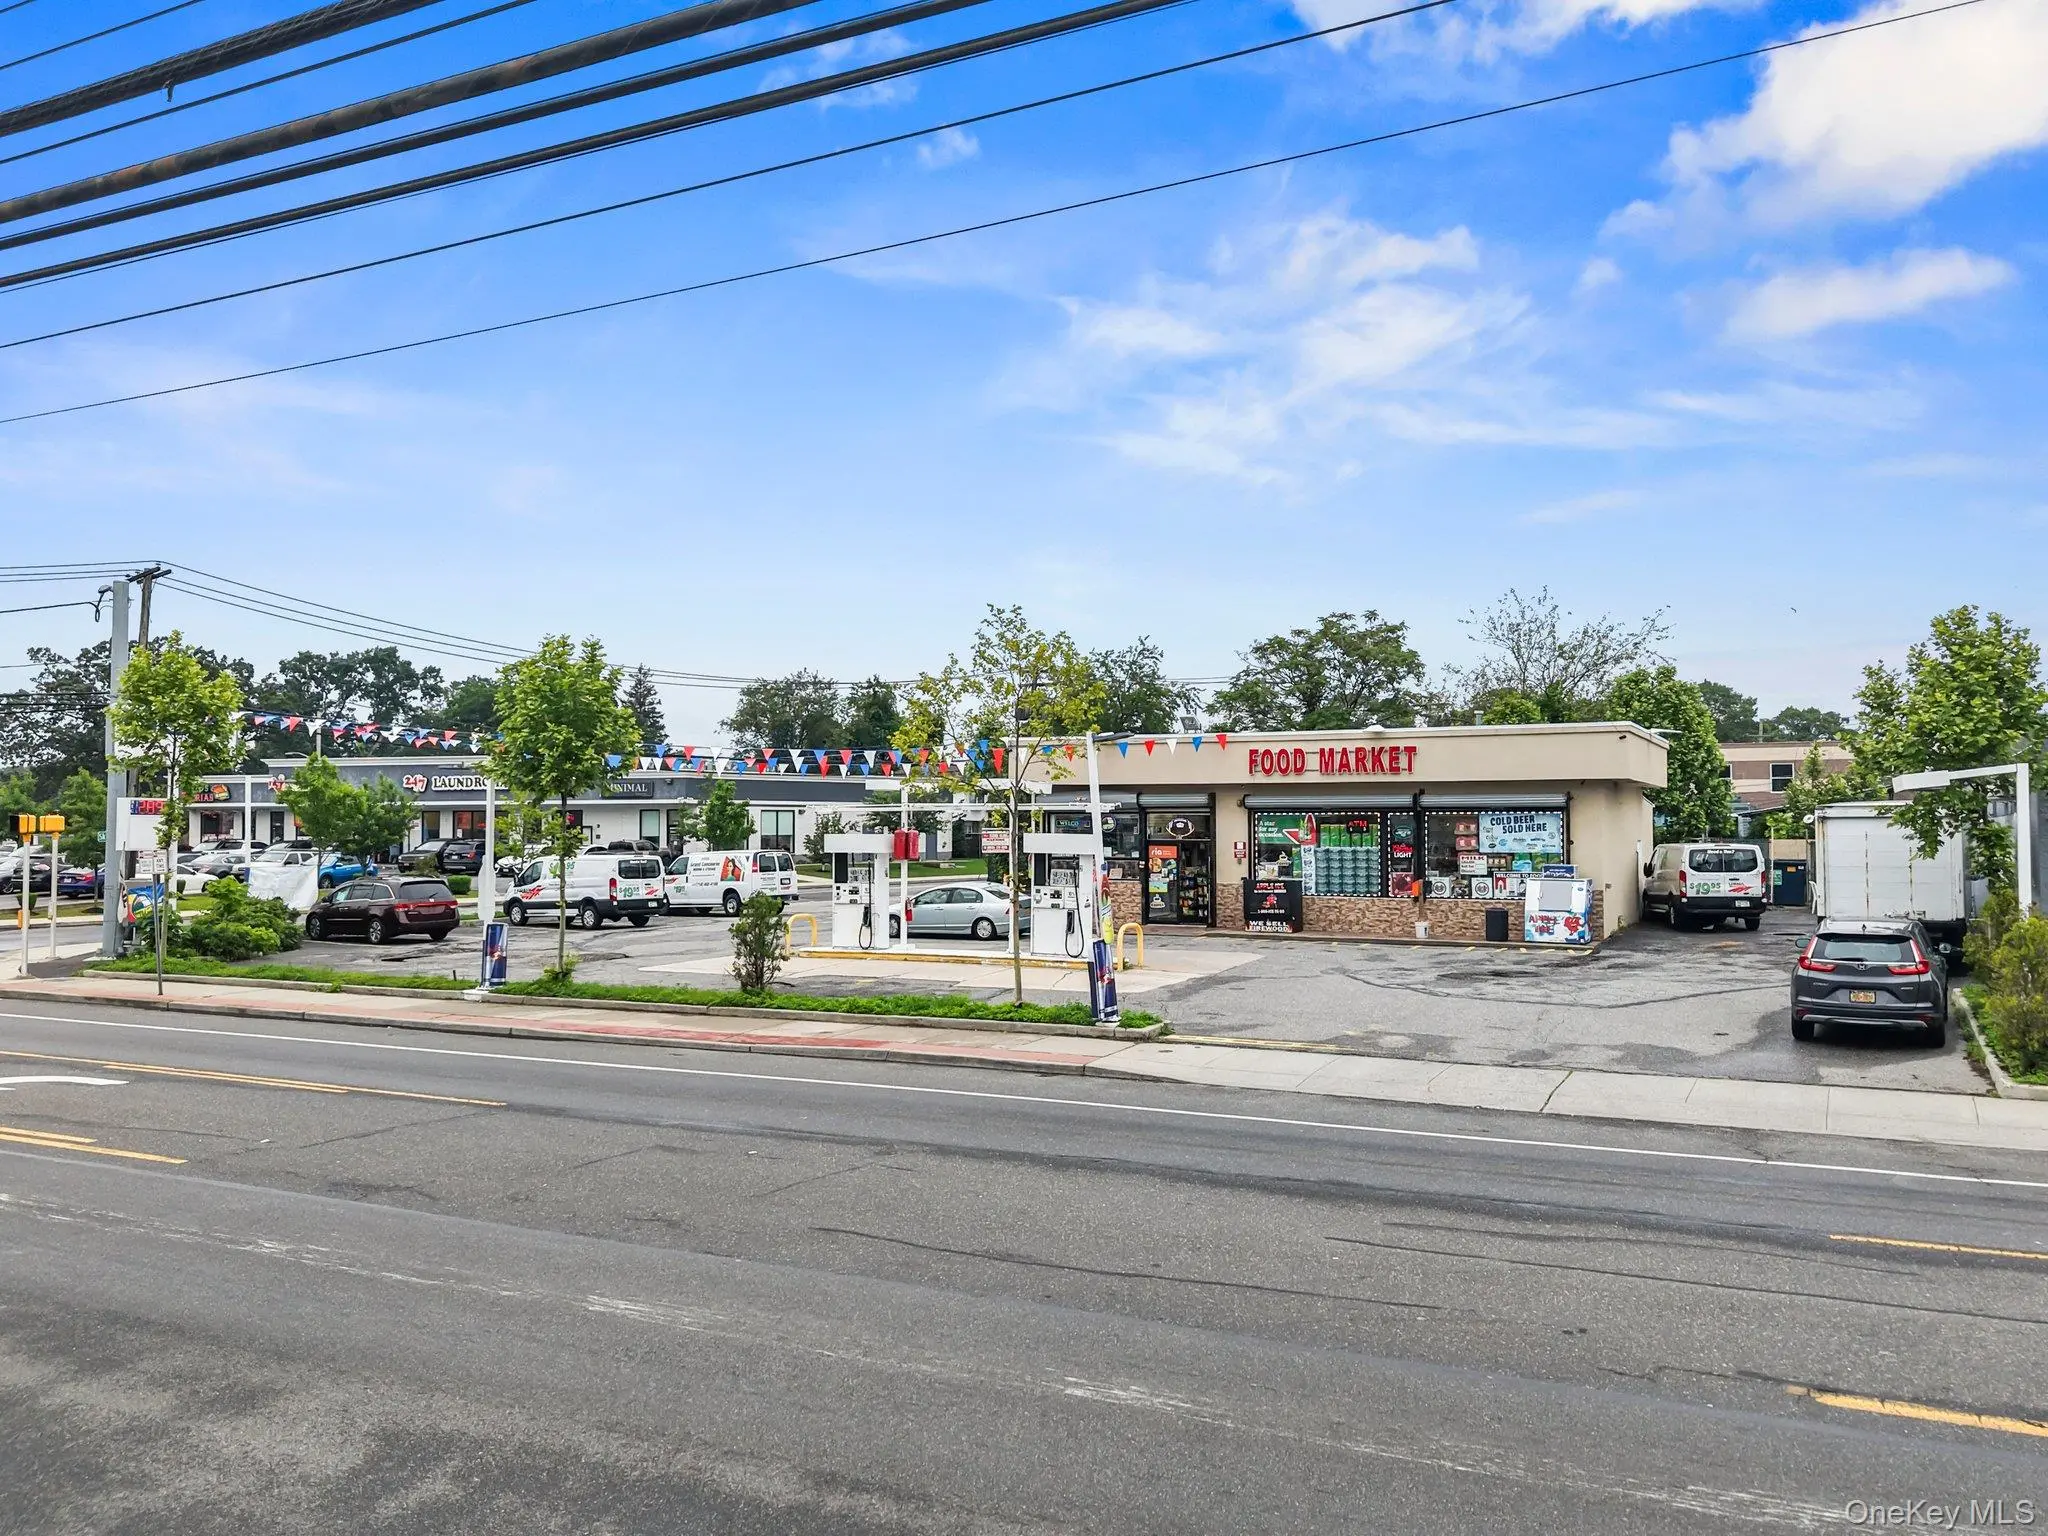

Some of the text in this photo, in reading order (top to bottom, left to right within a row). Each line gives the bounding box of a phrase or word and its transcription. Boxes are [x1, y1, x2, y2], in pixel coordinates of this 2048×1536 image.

[1248, 745, 1418, 776] FOOD MARKET
[1490, 814, 1535, 826] COLD BEER
[1502, 824, 1524, 834] SOLD
[1525, 822, 1547, 832] HERE
